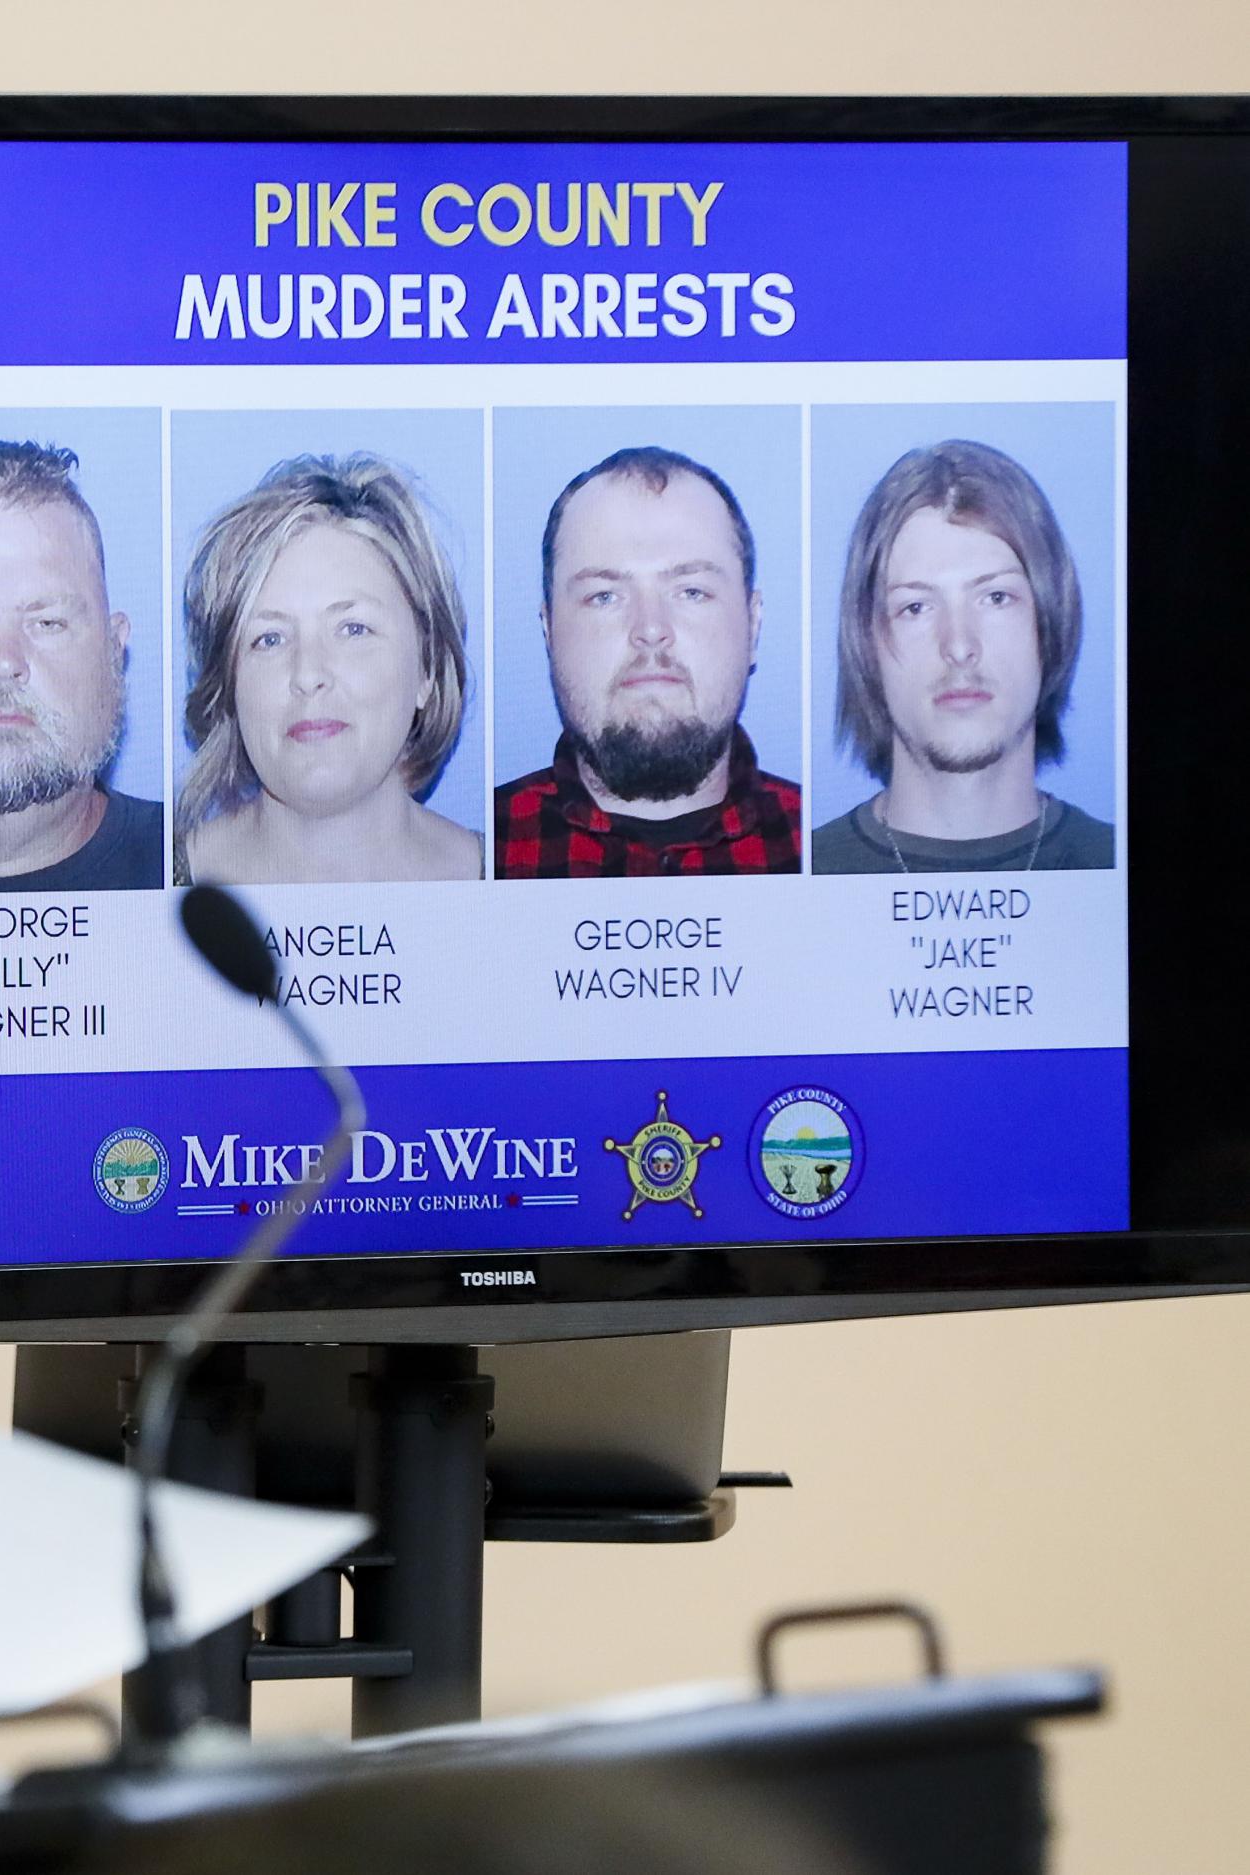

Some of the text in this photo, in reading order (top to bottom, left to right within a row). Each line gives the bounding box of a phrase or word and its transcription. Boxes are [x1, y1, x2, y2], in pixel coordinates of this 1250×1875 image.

[253, 180, 724, 247] PIKE COUNTY
[174, 272, 797, 341] MURDER ARRESTS
[892, 889, 1031, 922] EDWARD
[264, 924, 396, 957] ANGELA
[574, 918, 723, 951] GEORGE
[911, 935, 1013, 969] "JAKE"
[554, 966, 744, 1000] WAGNER IV
[889, 985, 1034, 1019] WAGNER
[83, 1004, 106, 1036] III
[767, 1088, 847, 1114] PIKE COUNTY
[312, 1197, 412, 1215] ATTORNEY
[419, 1194, 503, 1212] GENERAL
[766, 1192, 800, 1217] STATE
[460, 1271, 536, 1286] TOSHIBA
